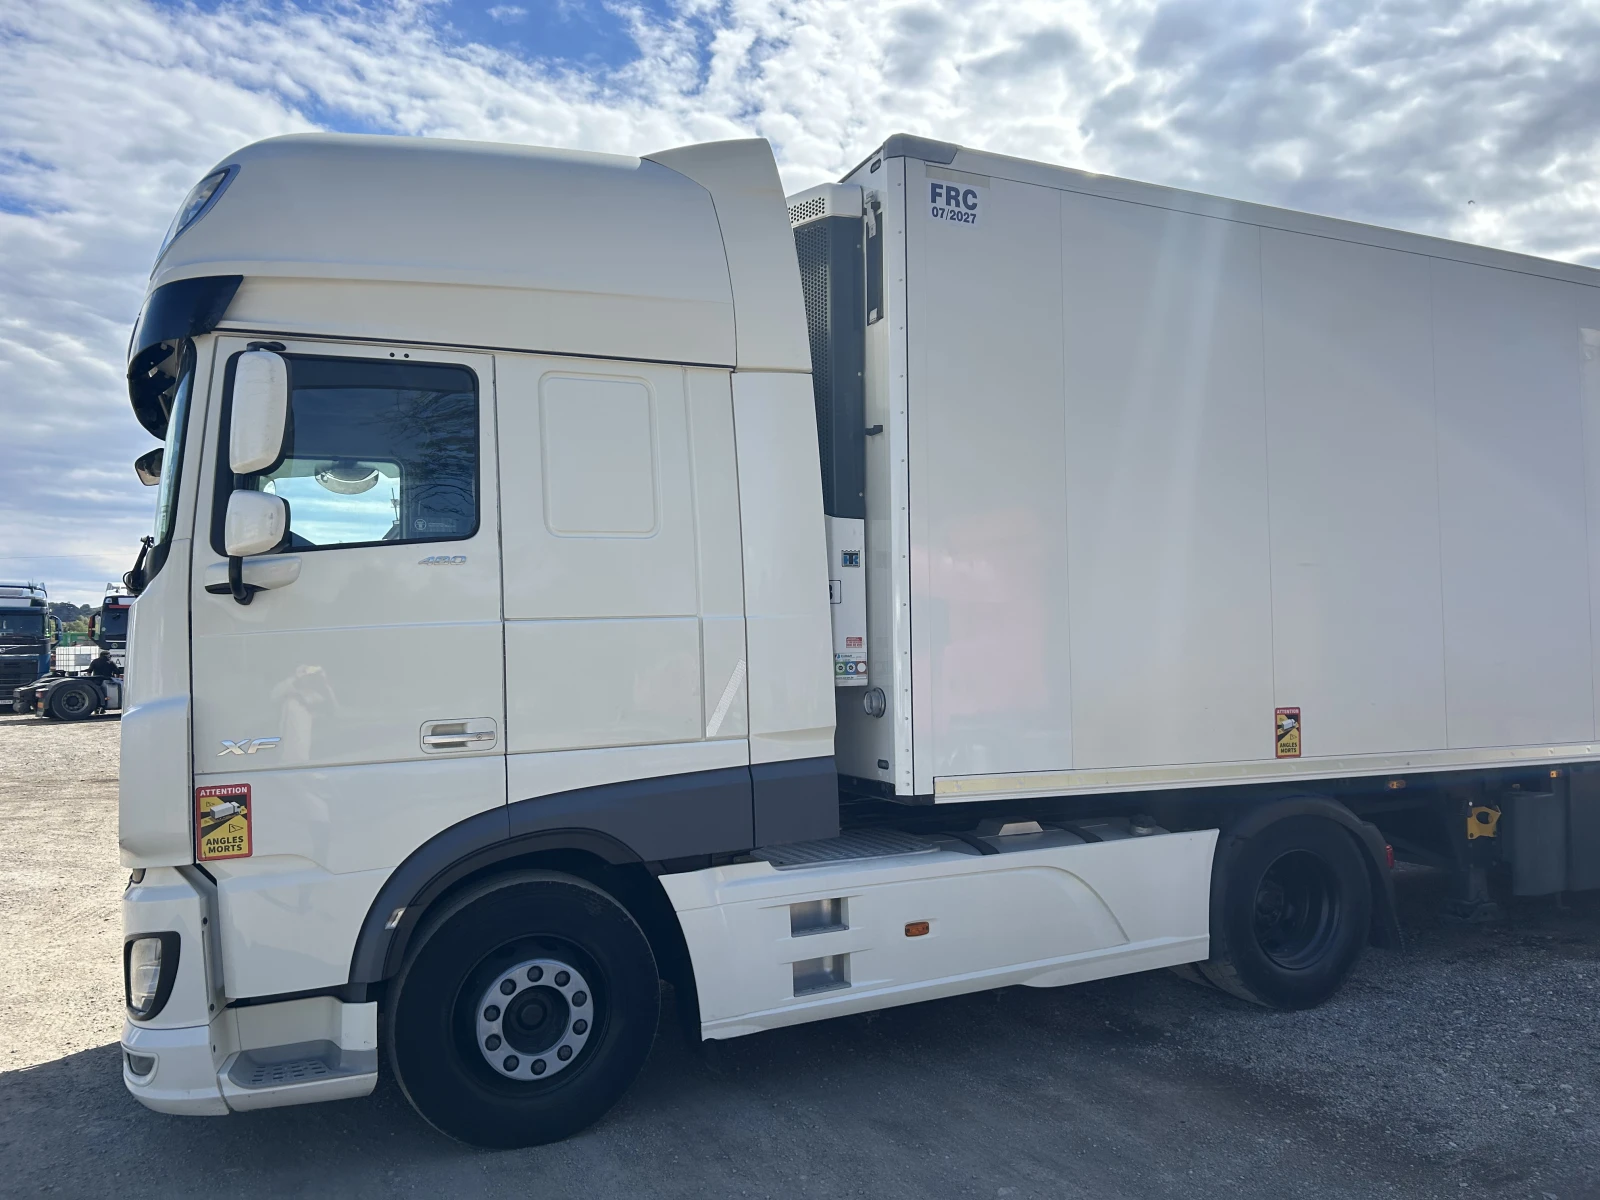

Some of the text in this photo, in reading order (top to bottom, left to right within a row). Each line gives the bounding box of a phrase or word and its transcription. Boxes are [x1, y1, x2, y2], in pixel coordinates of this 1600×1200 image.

[930, 182, 978, 211] FRC
[931, 206, 977, 224] 07/2027
[216, 736, 282, 757] XF
[200, 786, 248, 797] ATTENTION
[206, 835, 244, 846] ANGLES
[208, 843, 243, 854] MORTS
